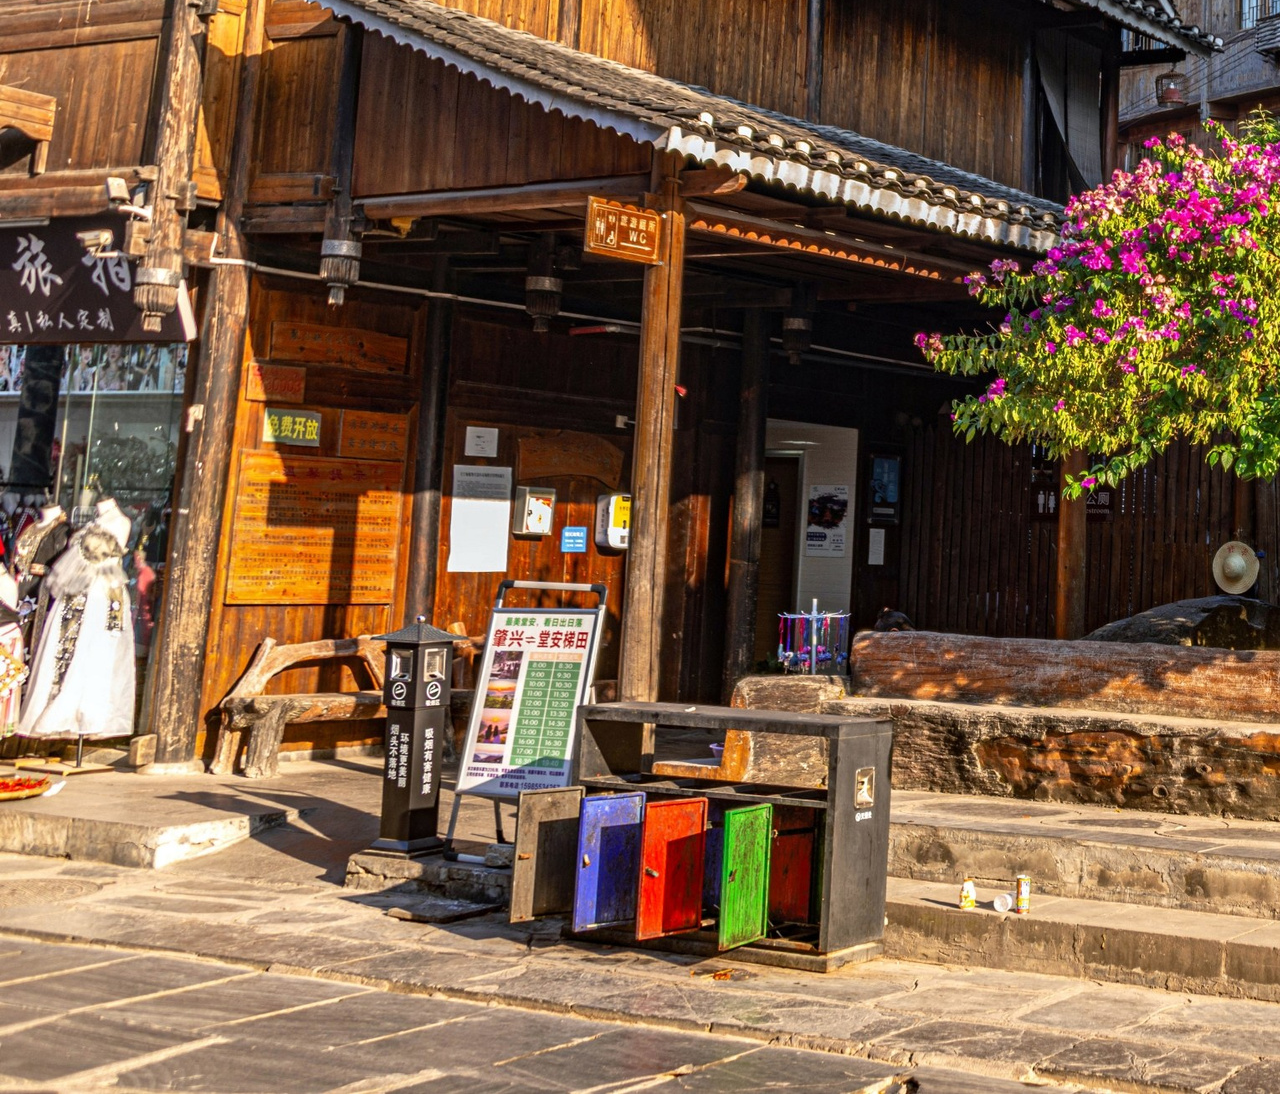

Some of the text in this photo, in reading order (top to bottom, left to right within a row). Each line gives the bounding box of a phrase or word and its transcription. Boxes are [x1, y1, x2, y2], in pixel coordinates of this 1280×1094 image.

[629, 229, 647, 244] WC
[267, 414, 319, 440] 免费开放
[1086, 491, 1110, 506] 公厕
[492, 629, 589, 649] 肇兴 堂安梯田
[387, 724, 400, 780] 烟头不落地
[398, 733, 409, 788] 环境更美丽
[421, 728, 434, 795] 吸烟有害健康
